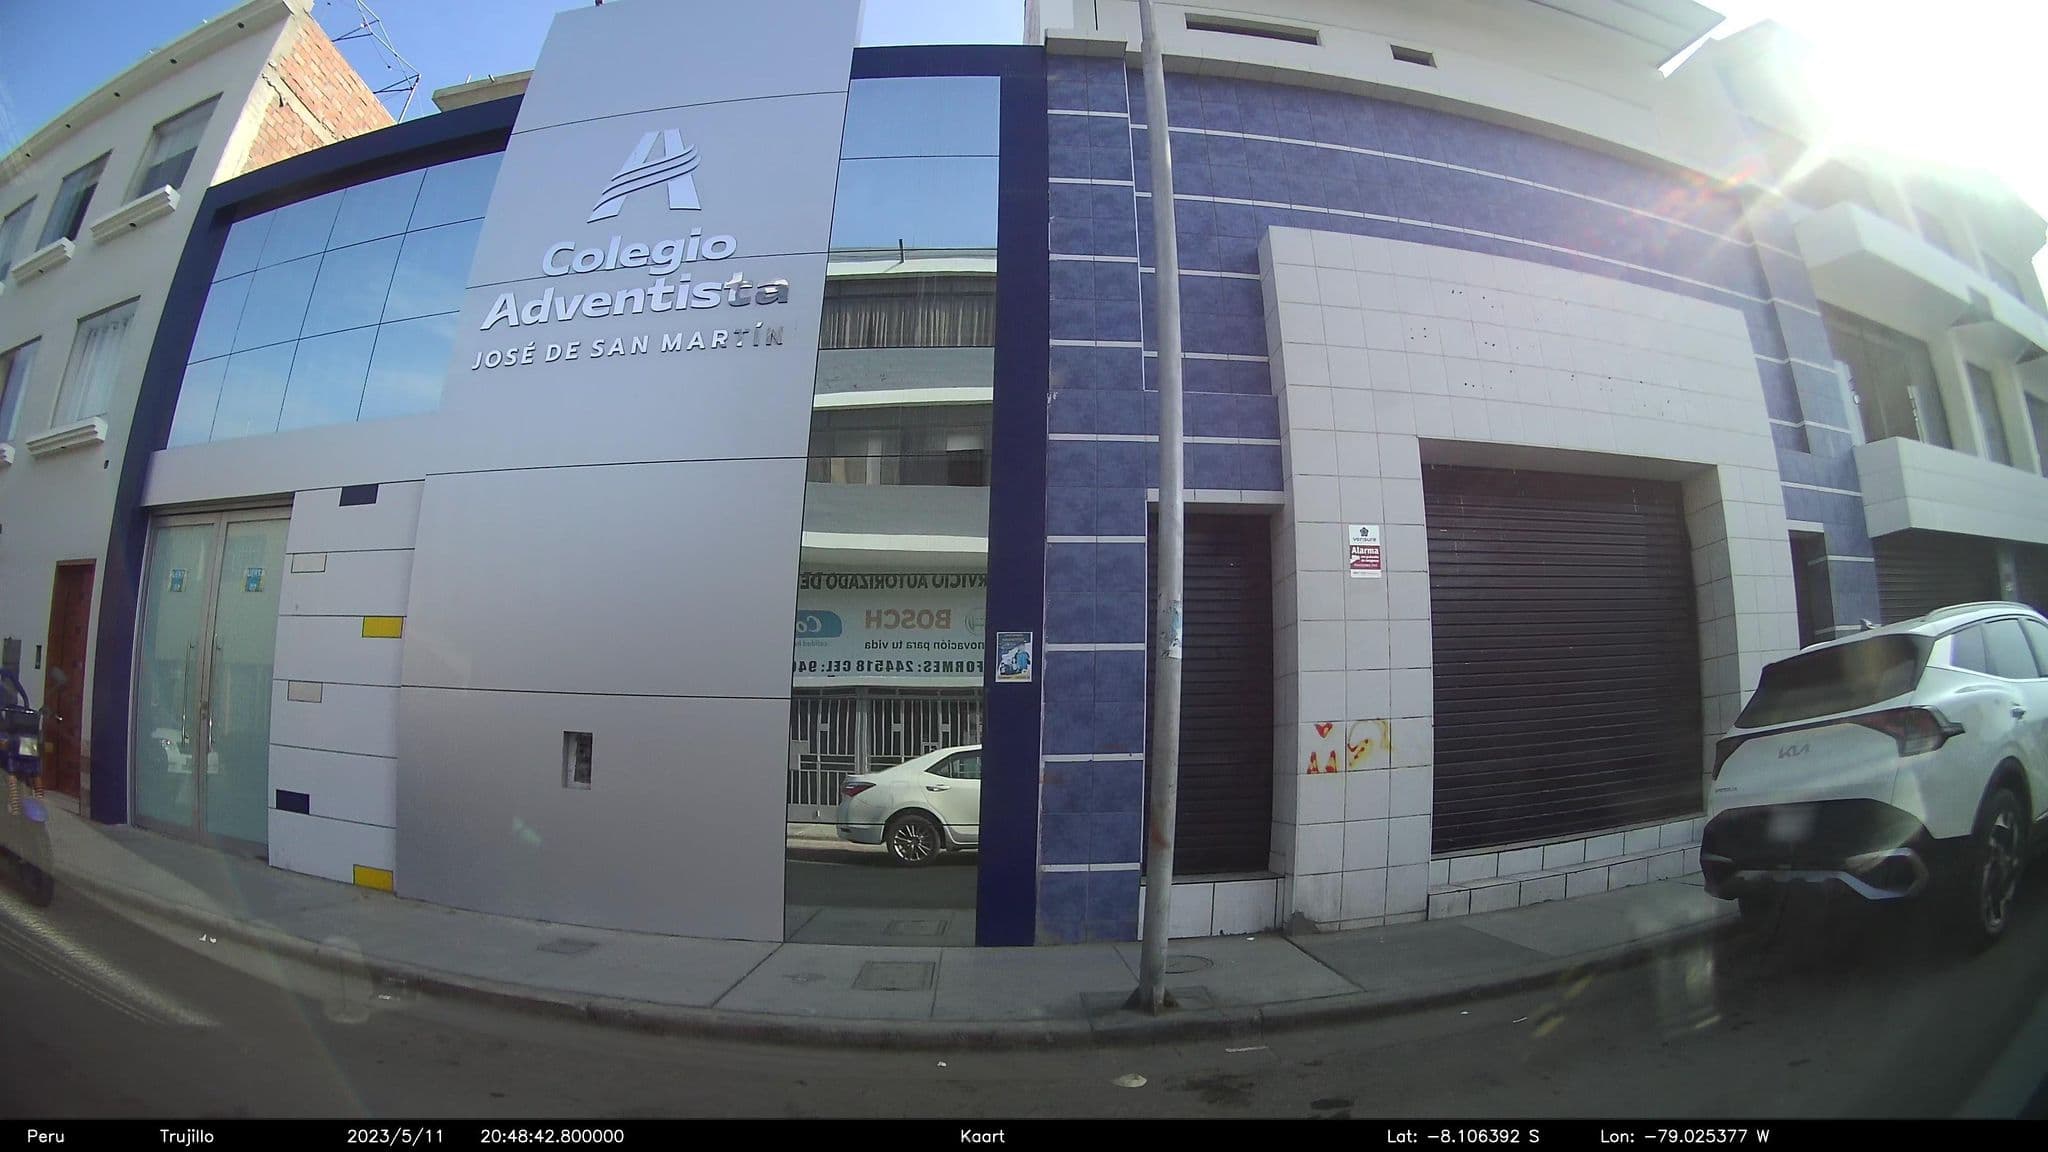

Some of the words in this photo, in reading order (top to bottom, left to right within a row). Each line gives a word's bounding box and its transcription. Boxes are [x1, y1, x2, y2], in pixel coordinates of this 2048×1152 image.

[542, 227, 738, 276] Colegio
[480, 272, 790, 330] Adventista
[472, 341, 537, 370] JOSÉ
[545, 341, 582, 362] DE
[590, 335, 650, 358] SAN
[661, 321, 786, 352] MARTÍN
[1351, 546, 1379, 554] Alarma
